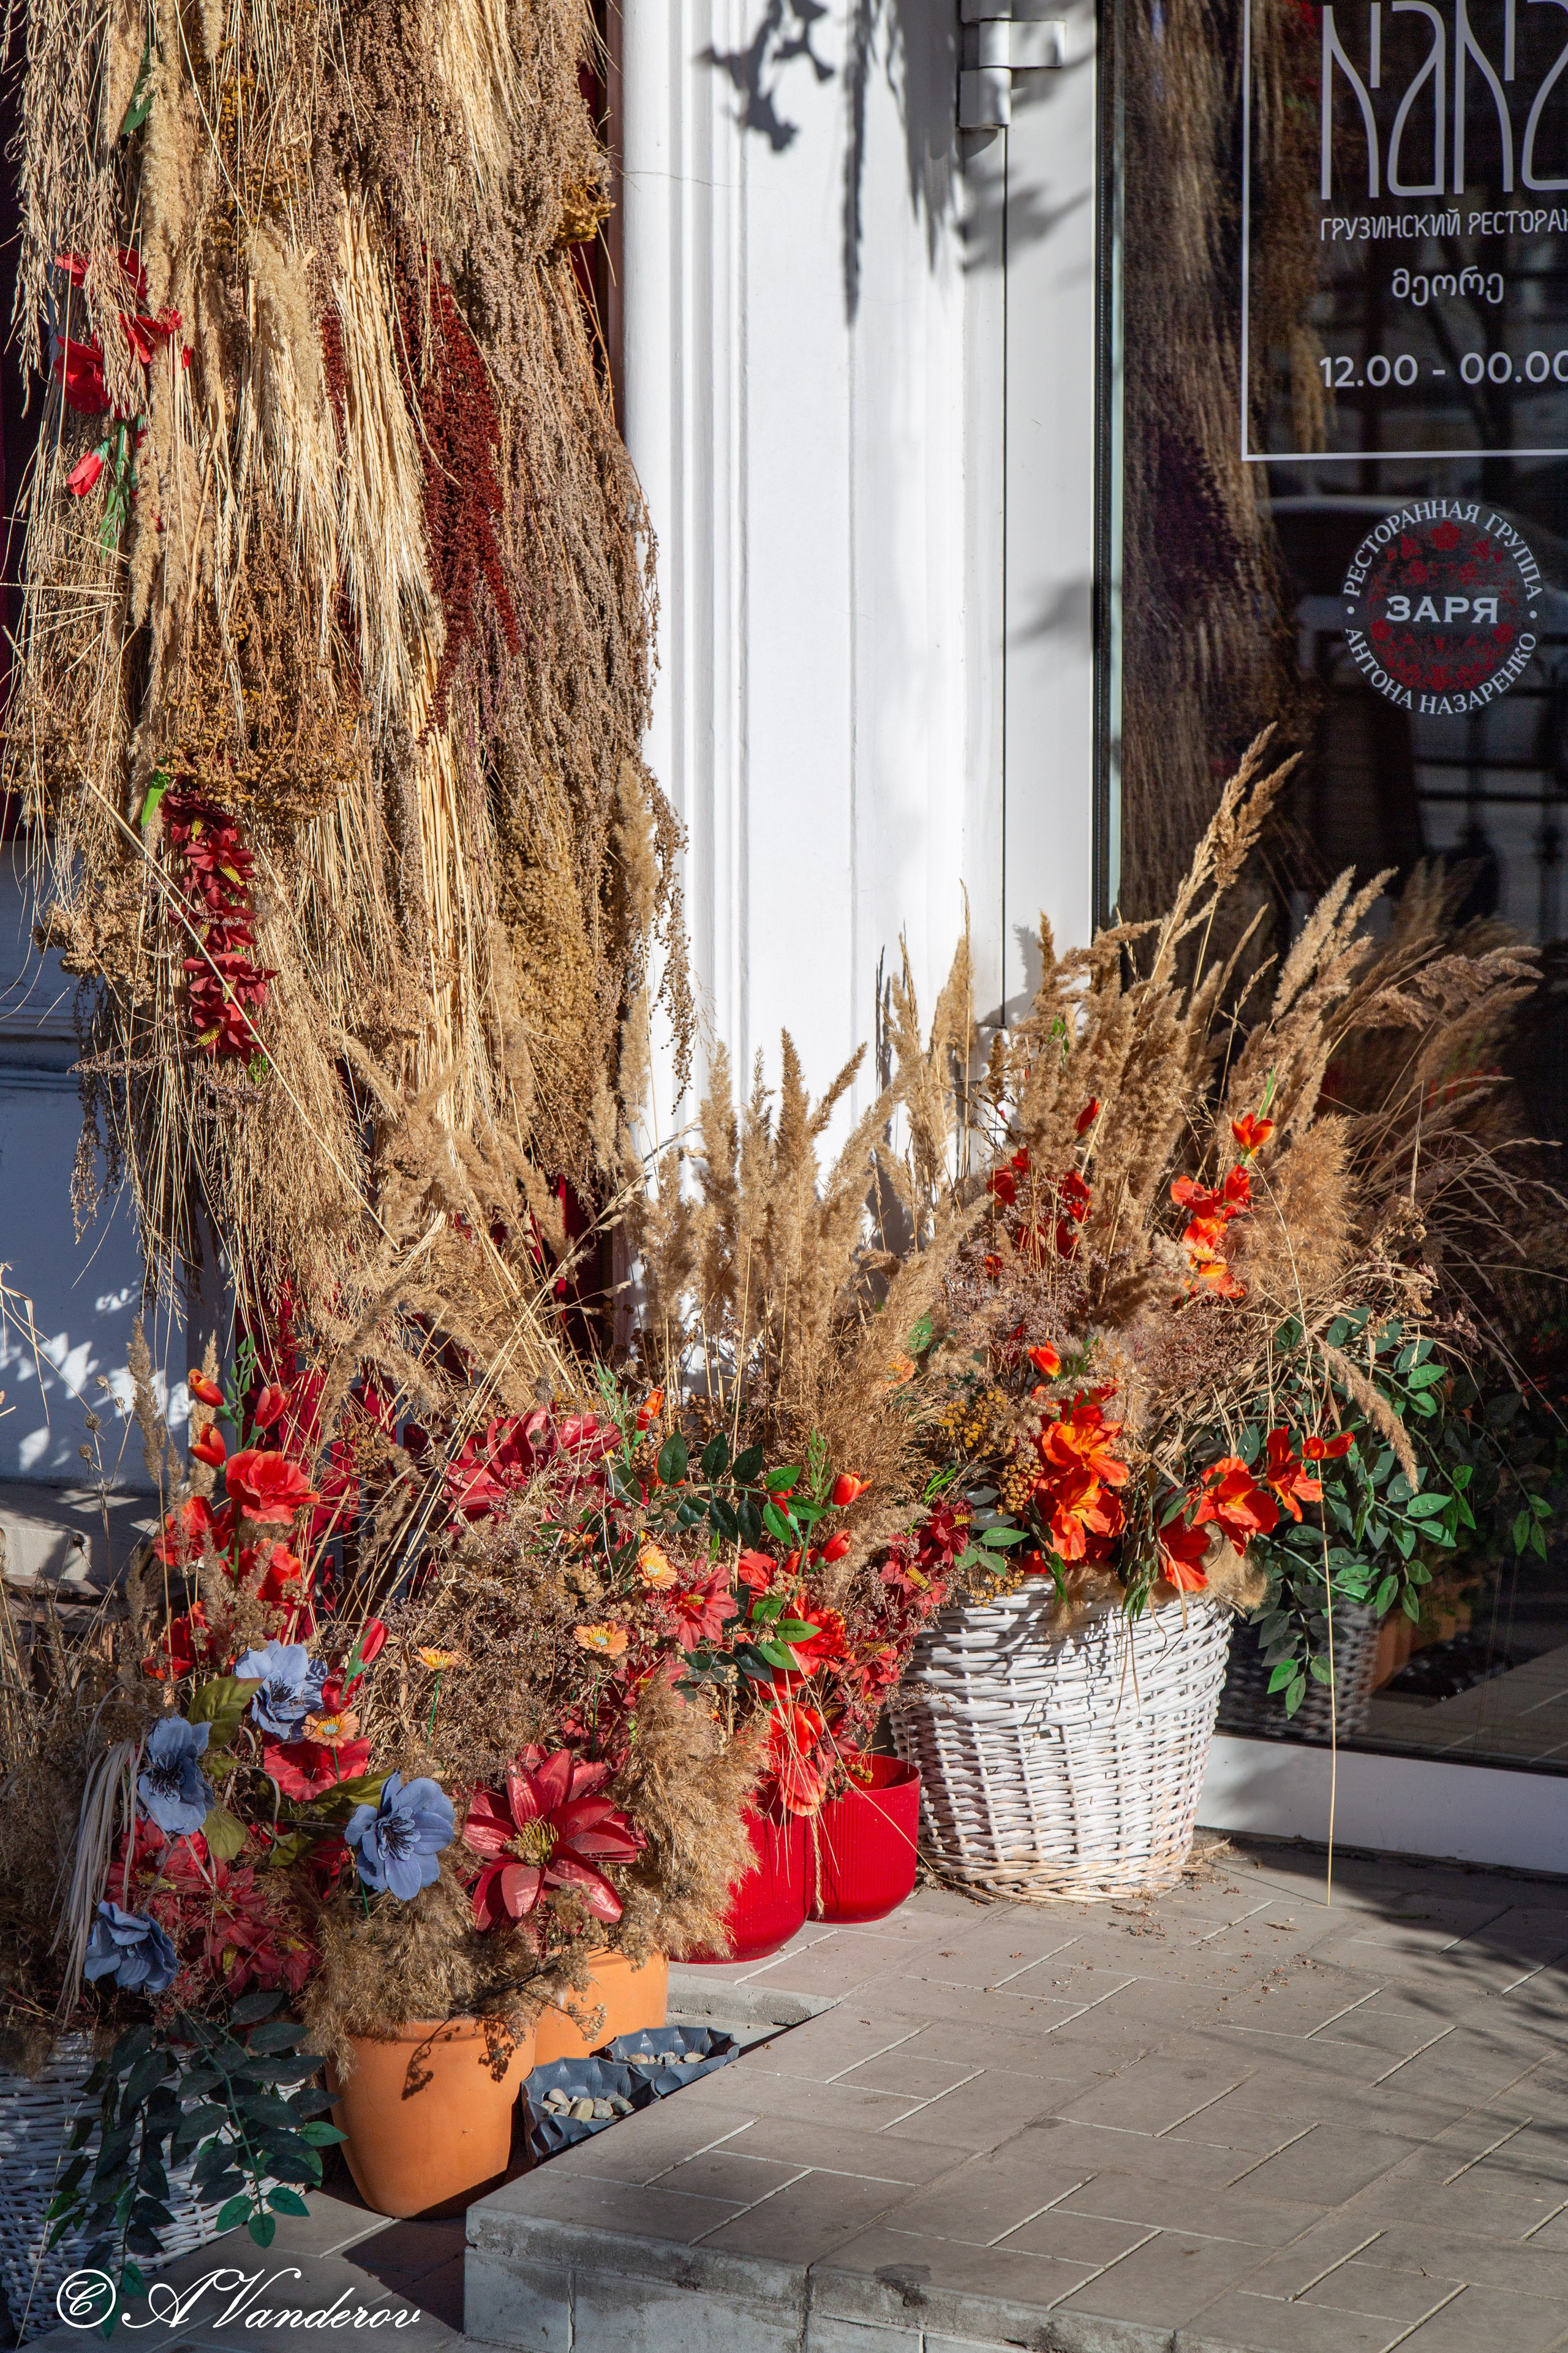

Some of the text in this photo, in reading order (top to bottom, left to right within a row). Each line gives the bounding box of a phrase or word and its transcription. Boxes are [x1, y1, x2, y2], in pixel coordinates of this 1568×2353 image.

[1321, 208, 1460, 241] ГРУЗИНСКИЙ
[1392, 266, 1503, 306] მეორე
[1319, 354, 1418, 387] 12.00
[1344, 499, 1543, 600] РЕСТОРАННАЯ ГРУППА
[1385, 595, 1499, 624] ЗАРЯ
[1345, 627, 1536, 715] АНТОНА НАЗАРЕНКО
